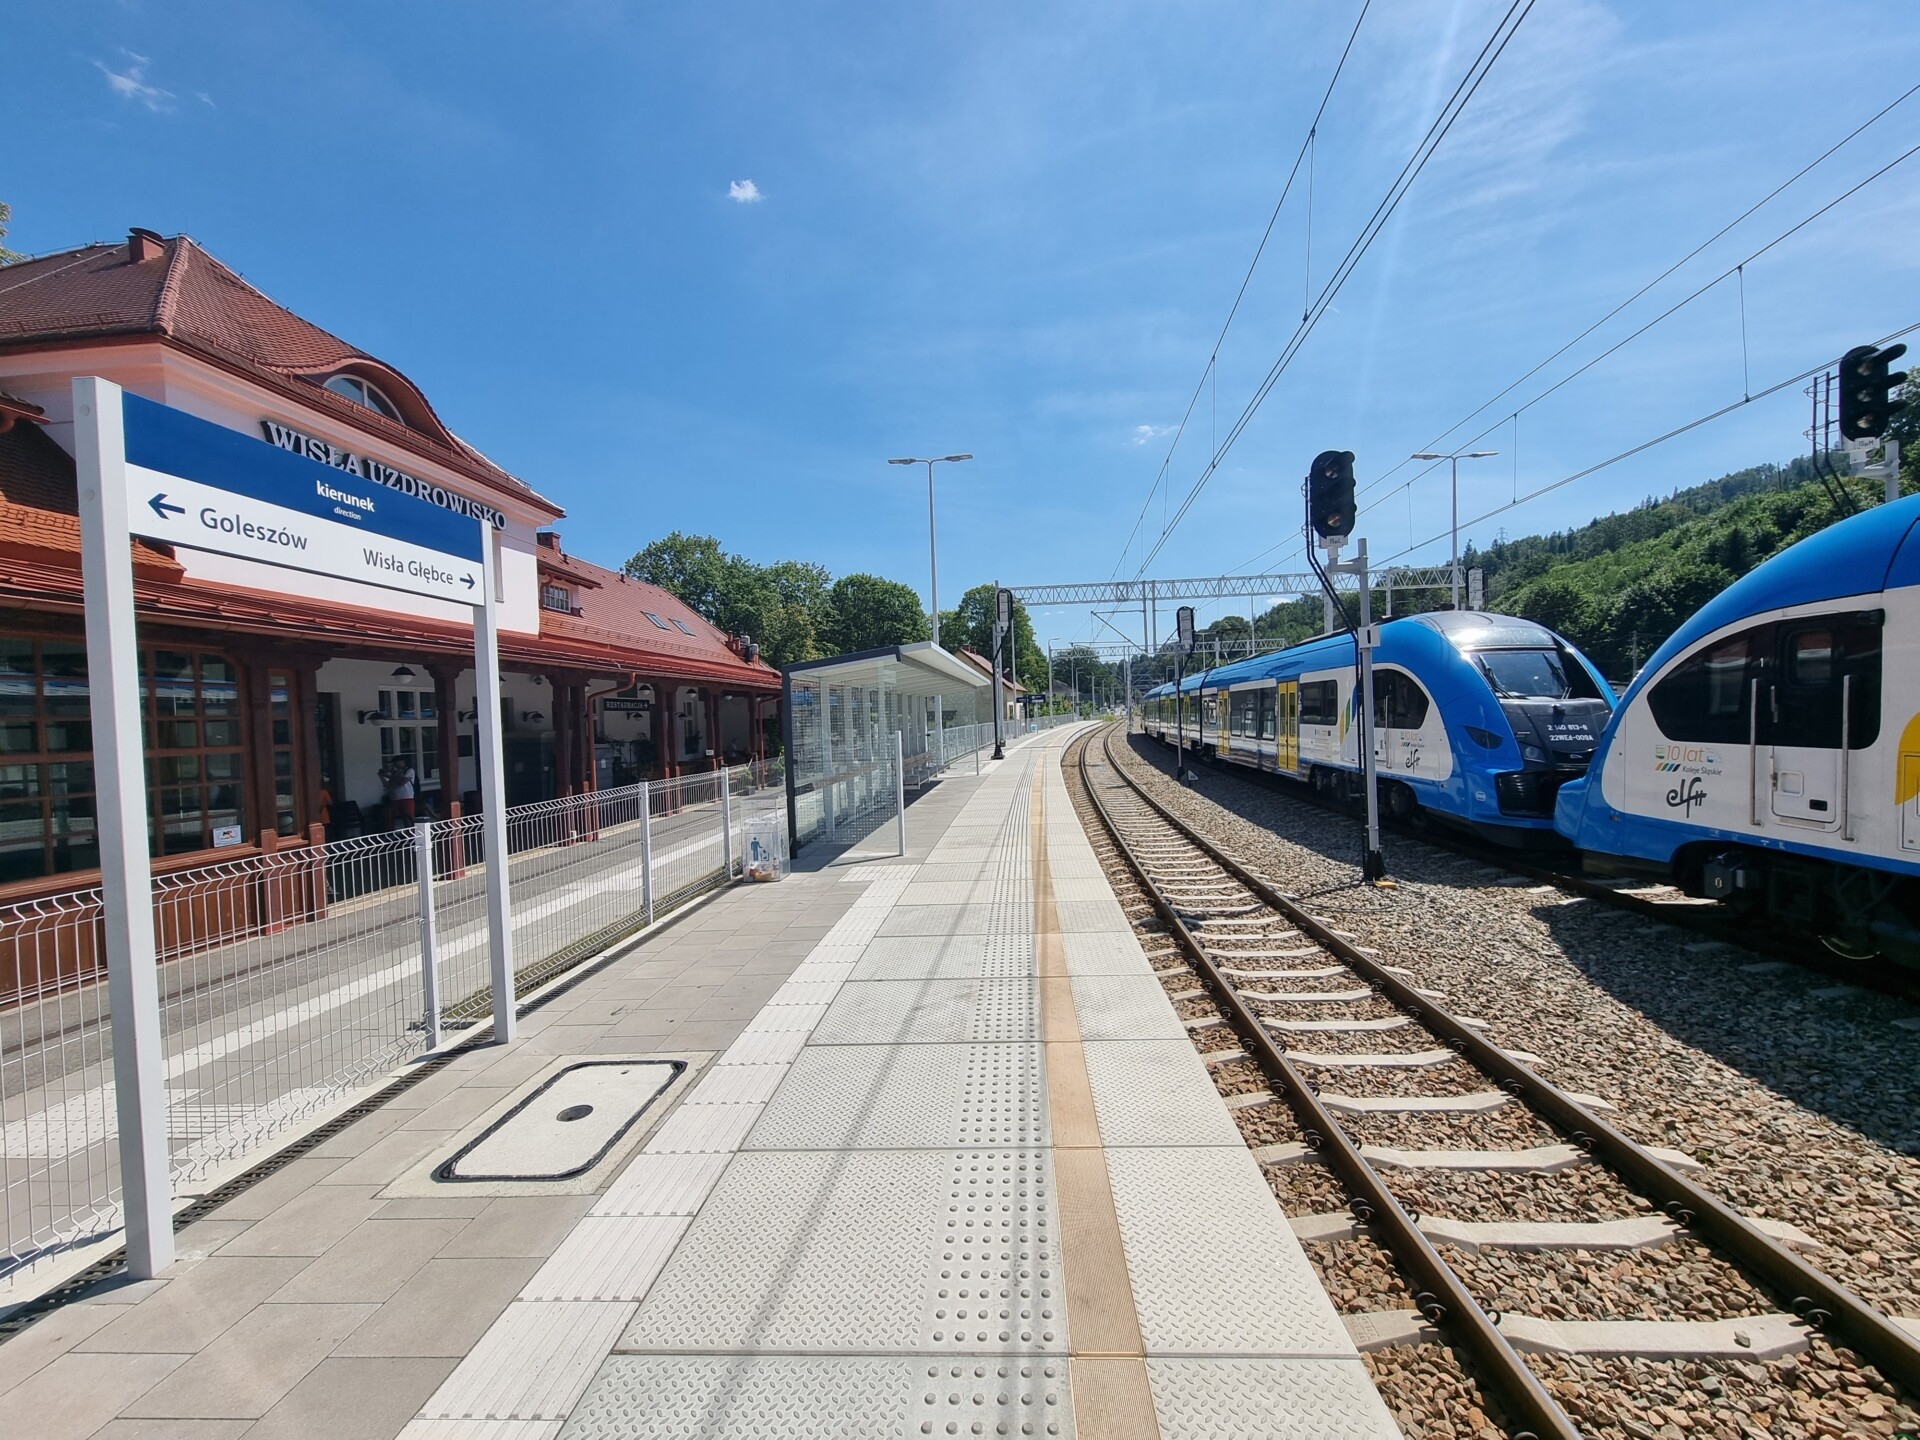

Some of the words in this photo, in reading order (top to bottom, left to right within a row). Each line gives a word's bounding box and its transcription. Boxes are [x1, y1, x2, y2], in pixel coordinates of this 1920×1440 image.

[262, 421, 364, 478] WISŁA
[366, 458, 507, 531] UZDROWISKO
[316, 480, 375, 513] kierunek
[200, 508, 308, 550] Goleszów
[333, 506, 362, 521] direction
[363, 548, 404, 574] Wisła
[407, 560, 454, 585] Głębce
[606, 701, 643, 709] RESTAURACJA
[1667, 745, 1681, 761] 10
[1683, 745, 1705, 763] lat
